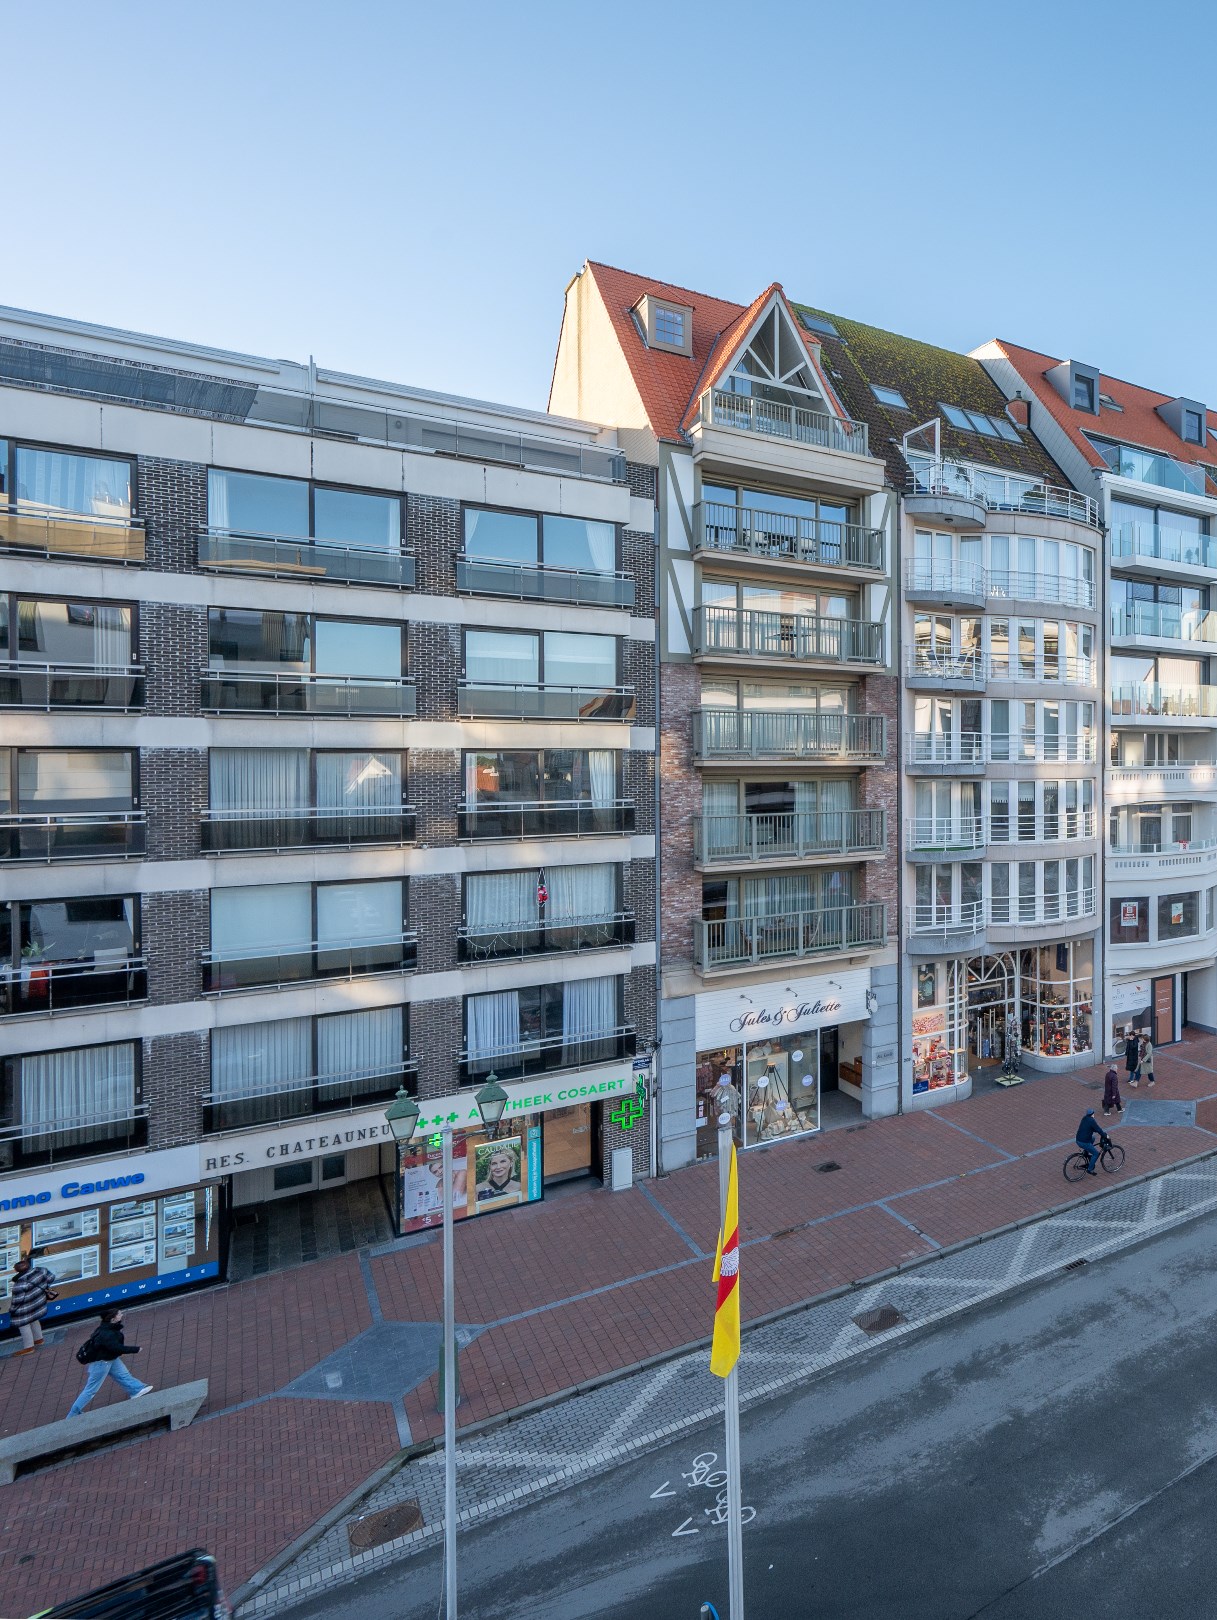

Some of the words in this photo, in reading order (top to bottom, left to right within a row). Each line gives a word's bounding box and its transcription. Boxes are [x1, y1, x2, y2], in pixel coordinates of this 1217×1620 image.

[729, 1008, 773, 1033] Jules
[772, 1006, 787, 1026] &
[786, 1000, 842, 1023] Juliette
[467, 1092, 553, 1119] ATHEEK
[557, 1078, 626, 1102] COSAERT
[205, 1152, 250, 1171] RES.
[266, 1124, 392, 1158] CHATEAUNEU
[61, 1172, 145, 1199] Cauwe
